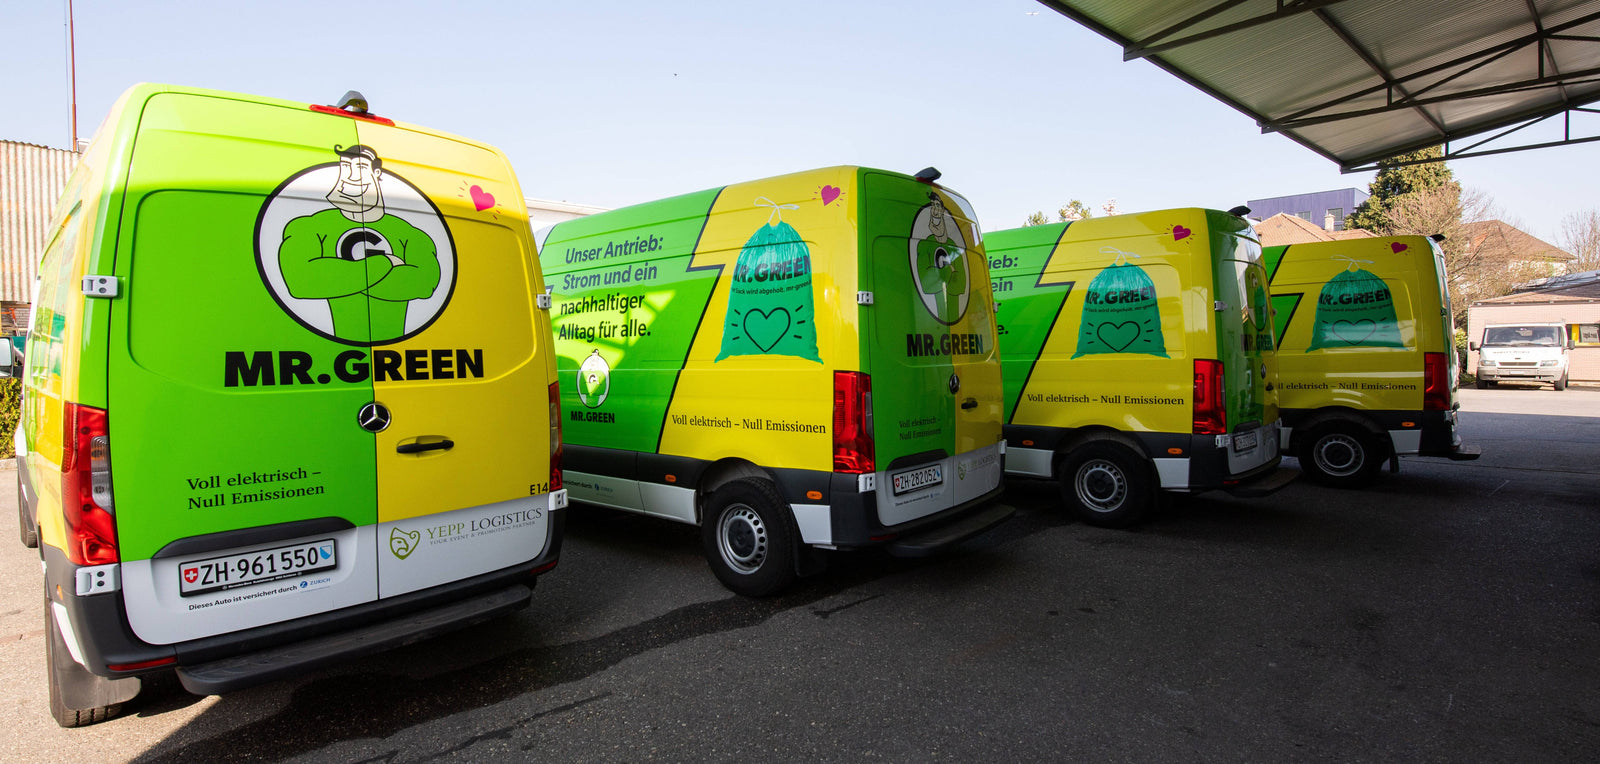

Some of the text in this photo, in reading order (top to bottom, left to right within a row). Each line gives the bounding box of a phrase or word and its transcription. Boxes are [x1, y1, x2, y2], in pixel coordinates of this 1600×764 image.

[565, 234, 664, 264] Unser Antrieb:
[988, 254, 1019, 270] ieb:
[562, 262, 658, 290] Strom und ein
[991, 276, 1013, 293] ein
[560, 292, 645, 315] nachhaltiger
[558, 319, 651, 343] Alltag für alle.
[906, 333, 984, 357] MR.GREEN
[224, 349, 484, 387] MR.GREEN
[1286, 382, 1329, 390] elektrisch
[1338, 382, 1358, 390] Null
[1361, 382, 1417, 391] Emissionen
[1027, 393, 1043, 402] Voll
[1045, 393, 1090, 403] elektrisch
[1100, 395, 1121, 404] Null
[1124, 395, 1184, 405] Emissionen
[570, 410, 615, 423] MR.GREEN
[672, 414, 687, 425] Voll
[689, 415, 732, 428] elektrisch
[742, 418, 763, 430] Null
[766, 419, 827, 434] Emissionen
[186, 475, 221, 490] Voll
[227, 467, 308, 487] elektrisch
[530, 482, 549, 495] E14
[188, 485, 325, 510] Null Emissionen
[426, 507, 542, 539] YEPP LOGISTICS
[188, 601, 213, 611] Dieses
[214, 597, 232, 607] Auto
[242, 589, 278, 600] versichert
[278, 584, 298, 594] durch
